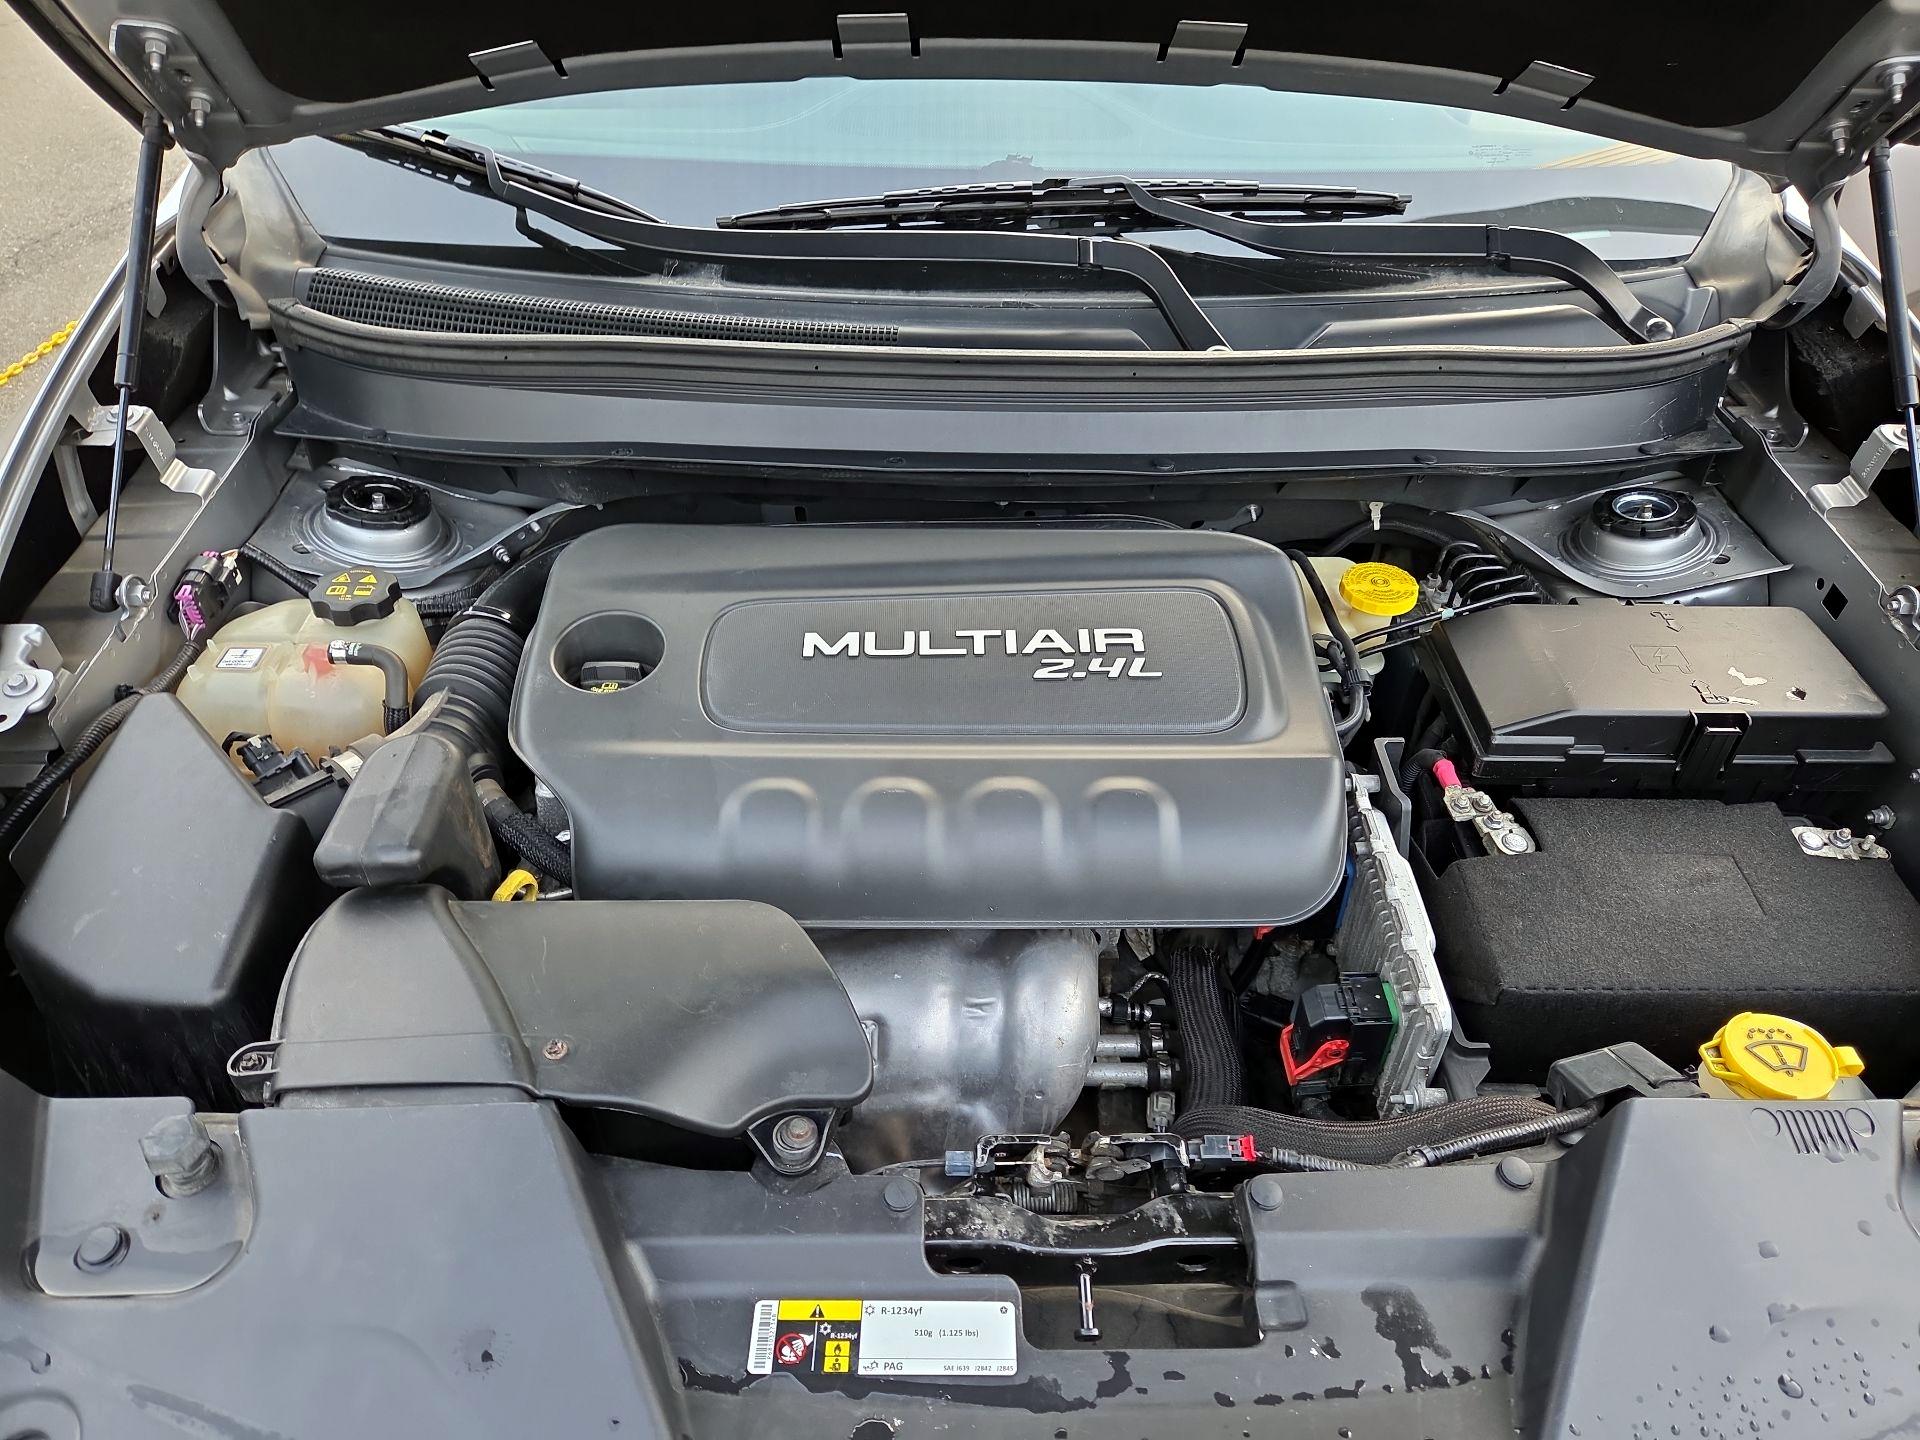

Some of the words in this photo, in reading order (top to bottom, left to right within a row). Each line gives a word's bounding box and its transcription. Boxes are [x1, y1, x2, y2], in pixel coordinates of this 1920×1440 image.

[802, 628, 1147, 657] MULTIAIR
[1032, 657, 1163, 680] 2.4L
[881, 1306, 923, 1317] R-1234yf
[914, 1328, 933, 1338] 510g
[939, 1328, 963, 1338] (1.125
[964, 1328, 979, 1338] lbs)
[883, 1361, 904, 1371] PAG
